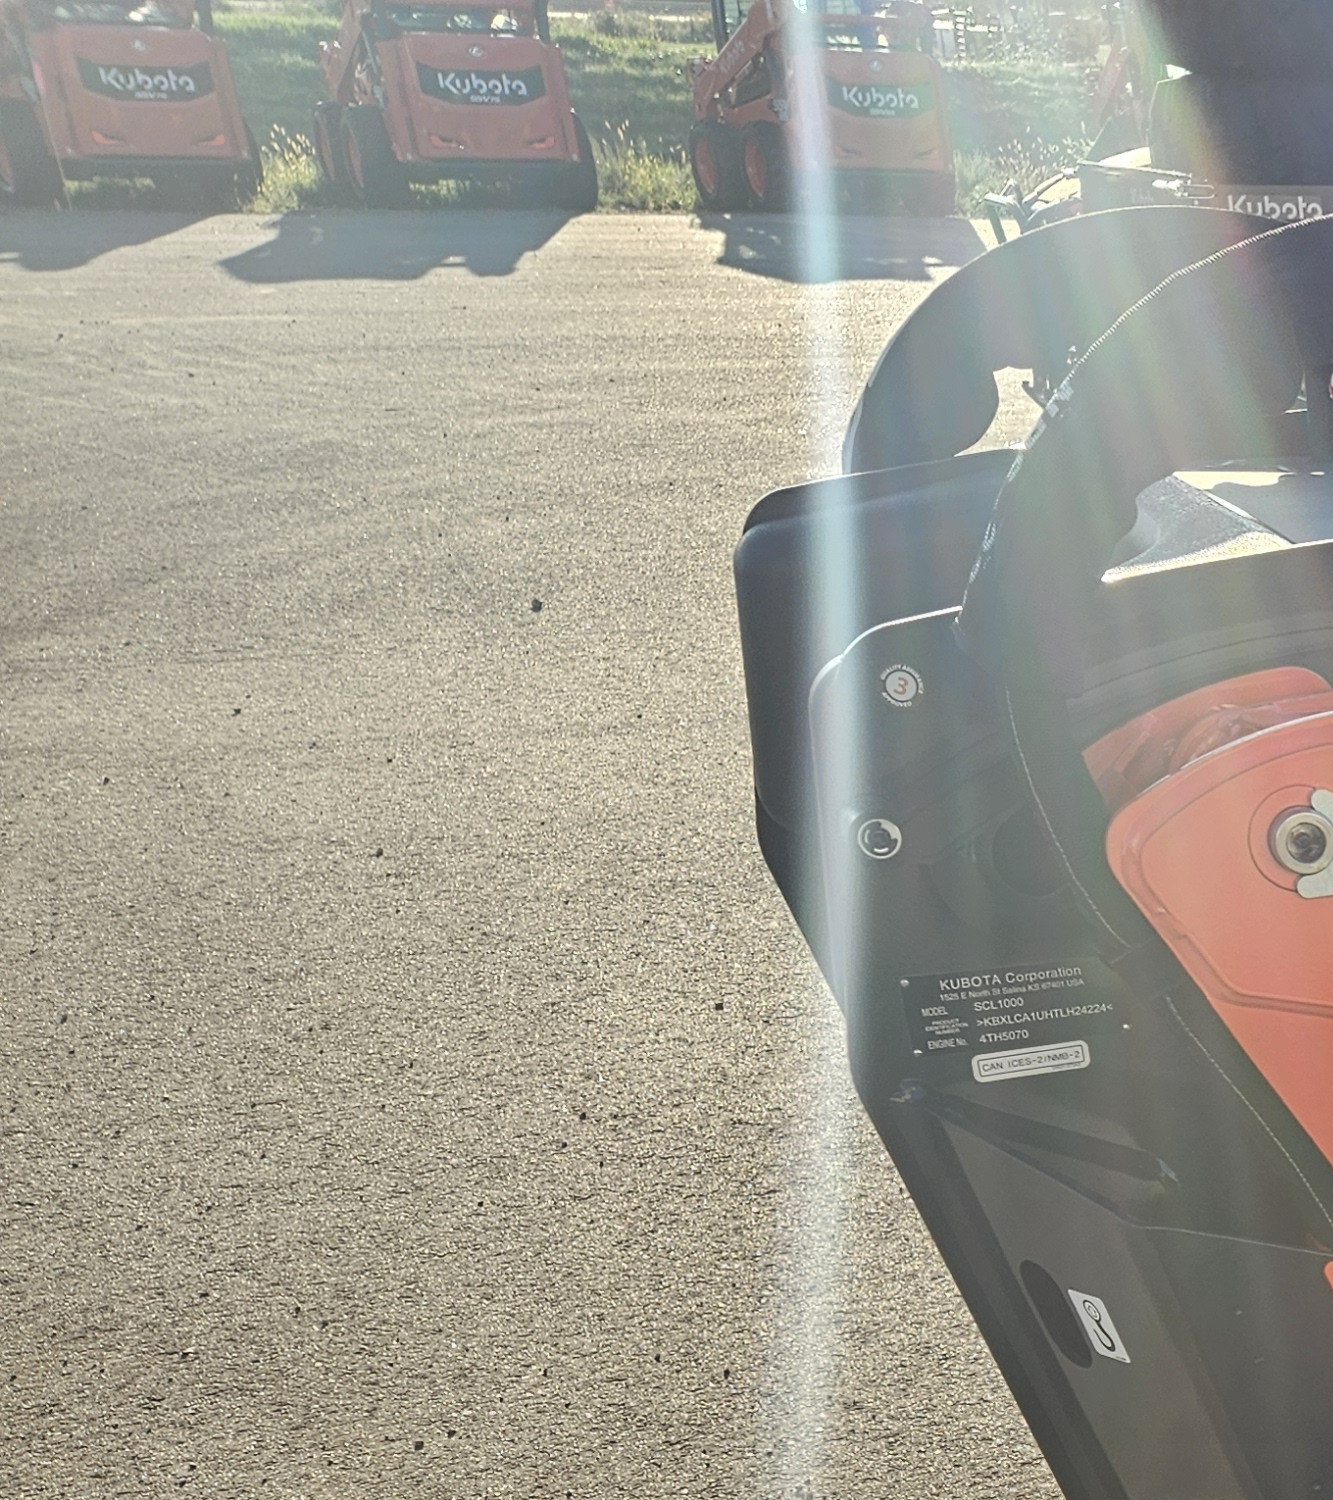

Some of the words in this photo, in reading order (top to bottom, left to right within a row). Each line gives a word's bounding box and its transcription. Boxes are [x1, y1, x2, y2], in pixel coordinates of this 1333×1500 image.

[98, 67, 195, 92] Kubota
[437, 72, 528, 96] Kubota
[842, 85, 919, 109] Kubota
[1227, 194, 1323, 220] Kubota
[893, 677, 909, 695] 3
[939, 974, 1002, 991] KUBOTA
[1005, 966, 1082, 984] Corporation
[940, 993, 960, 1001] 1525
[960, 991, 968, 999] E
[1002, 984, 1027, 994] Salina
[1028, 982, 1040, 991] KS
[1066, 977, 1086, 987] USA
[921, 1006, 949, 1017] MODEL
[973, 997, 1025, 1012] SCL1000
[927, 1038, 956, 1050] ENGINE
[979, 1029, 1030, 1044] 4TH5070
[982, 1062, 1004, 1073] CAN
